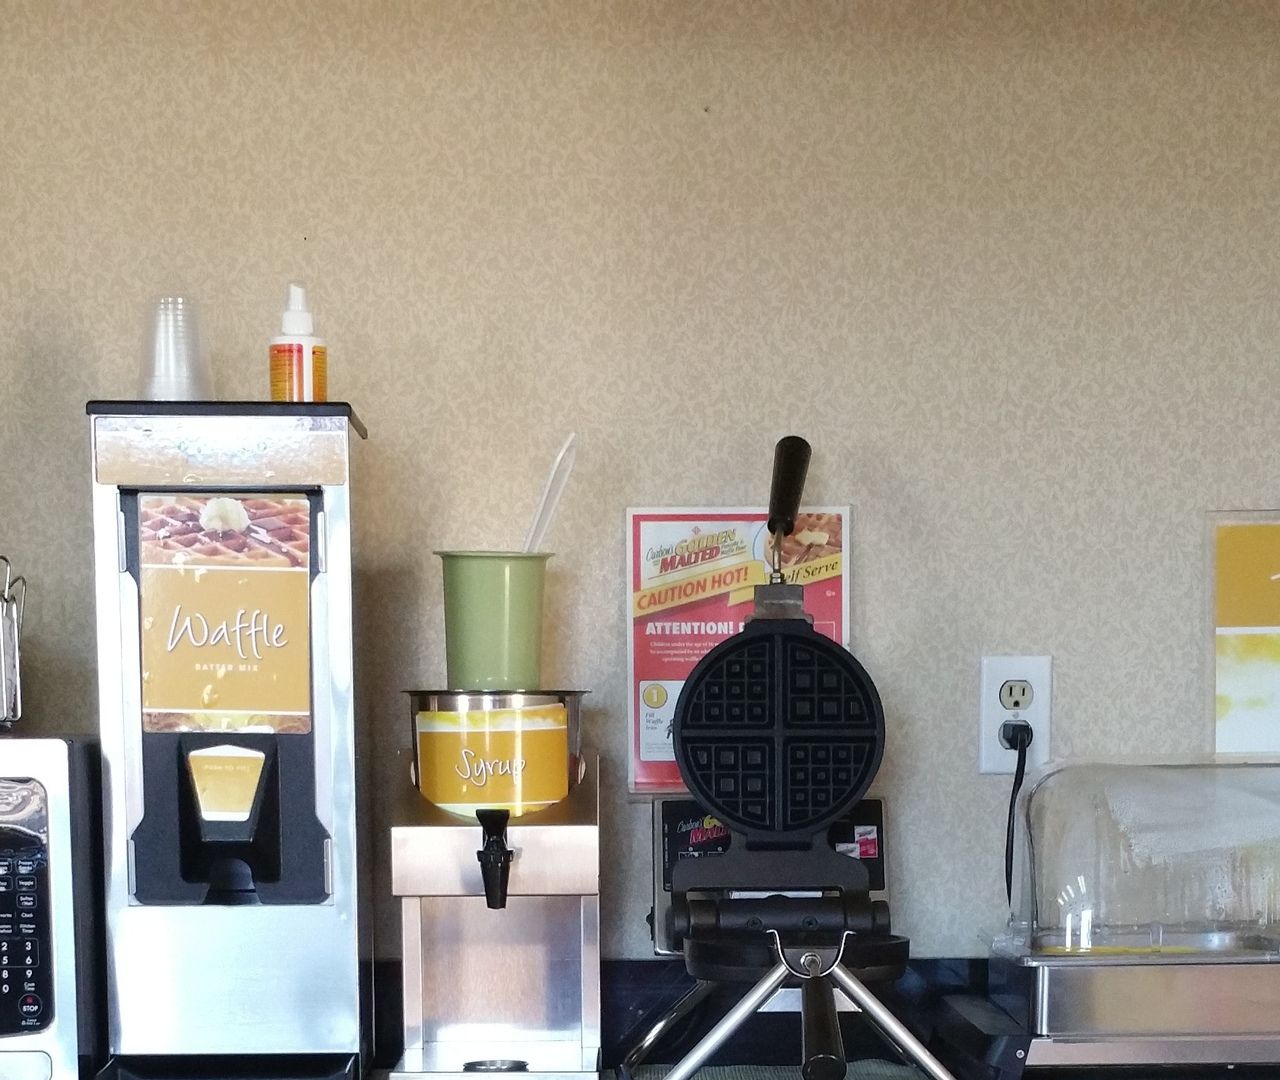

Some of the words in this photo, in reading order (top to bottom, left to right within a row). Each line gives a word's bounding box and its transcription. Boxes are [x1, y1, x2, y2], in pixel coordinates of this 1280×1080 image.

[674, 528, 737, 557] GOLDEN
[659, 546, 721, 574] MALTED
[802, 560, 839, 579] Serve
[637, 577, 707, 610] CAUTION
[711, 566, 749, 591] HOT!
[166, 603, 289, 660] Waffle
[645, 621, 735, 635] ATTENTION!
[195, 663, 234, 672] BATTER
[238, 664, 259, 672] MIX
[651, 688, 658, 702] 1
[454, 748, 526, 787] Syrup
[1, 942, 8, 951] 2
[25, 941, 32, 951] 3
[2, 955, 9, 965] 5
[25, 955, 33, 965] 6
[2, 969, 9, 979] 8
[25, 969, 33, 979] 9
[2, 984, 10, 993] 0
